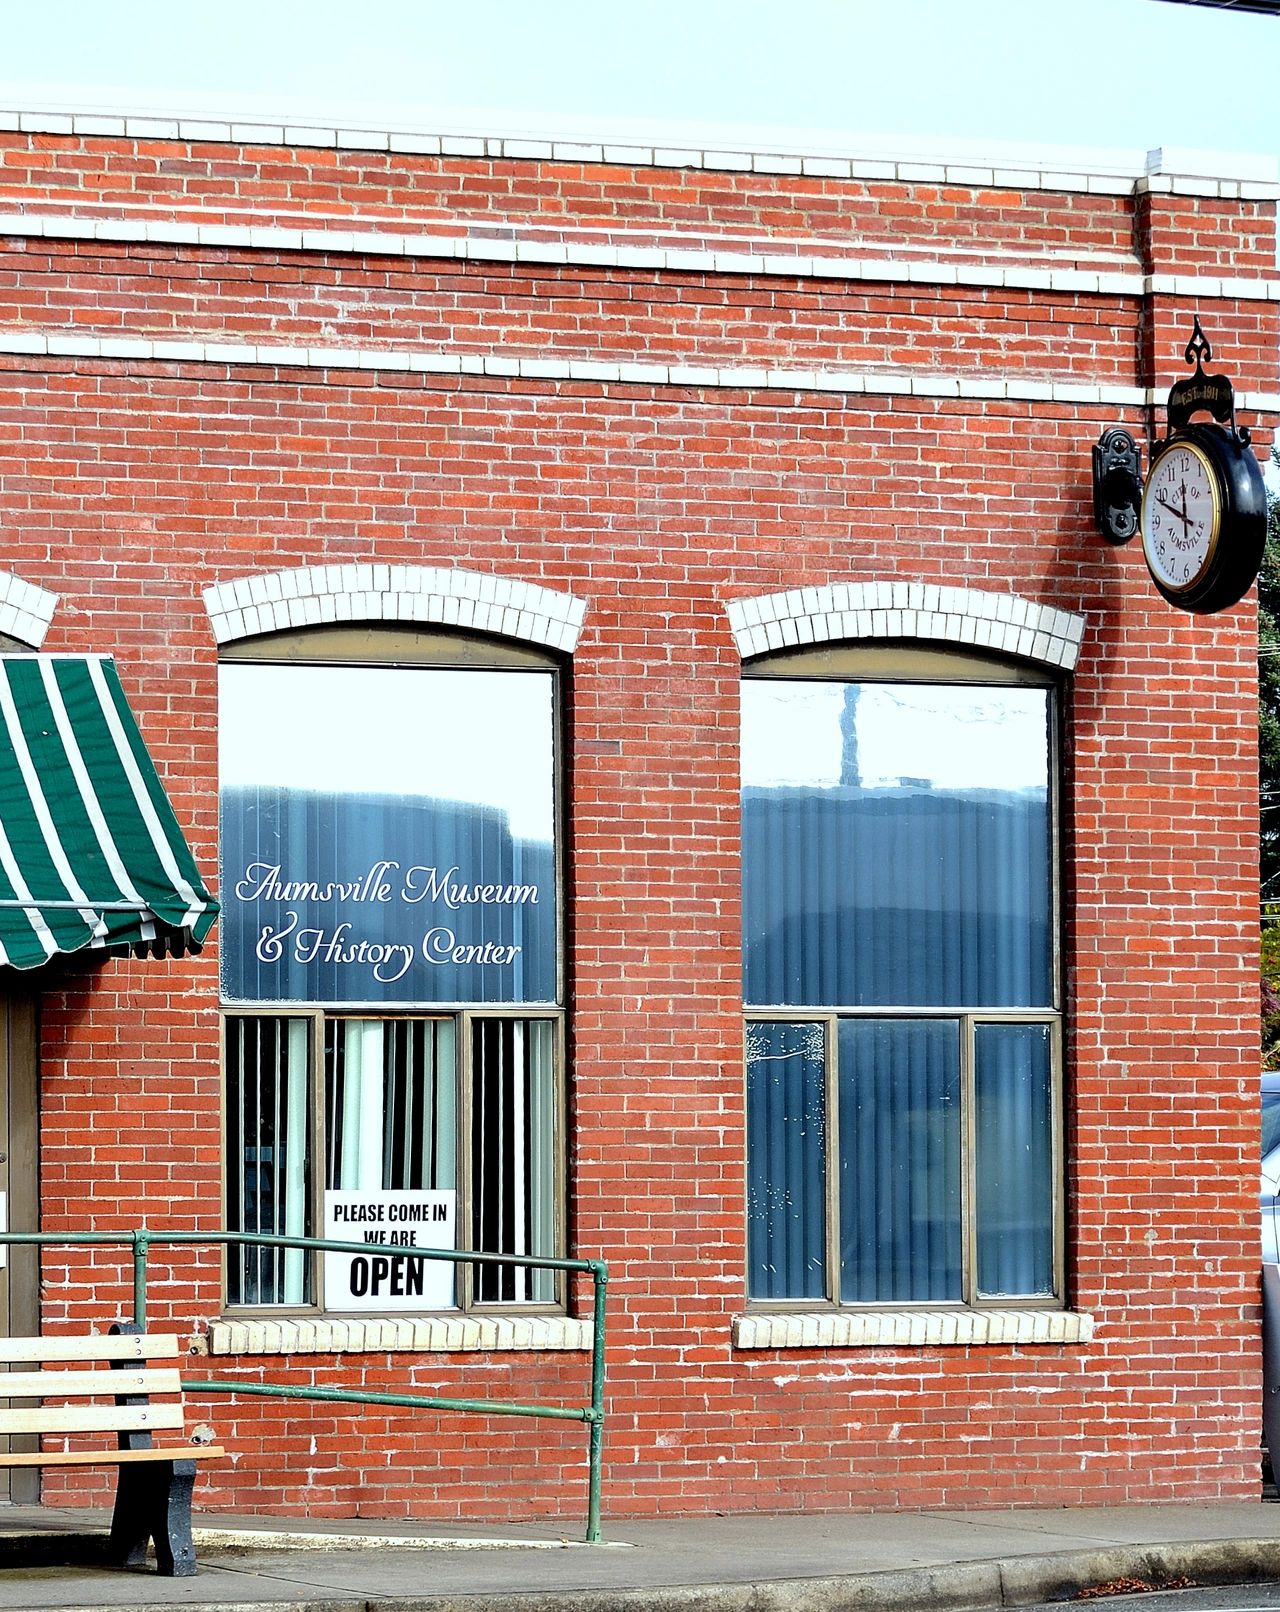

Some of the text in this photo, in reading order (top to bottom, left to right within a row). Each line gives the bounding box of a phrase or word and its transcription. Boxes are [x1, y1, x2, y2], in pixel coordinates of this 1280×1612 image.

[1203, 385, 1218, 401] 1911
[1181, 457, 1190, 472] 12
[1198, 463, 1202, 477] 1
[1168, 467, 1175, 482] 11
[1158, 487, 1168, 503] 10
[1171, 484, 1201, 504] CITY OF
[1154, 515, 1161, 530] 9
[1168, 521, 1205, 551] AUMSVILLE
[1159, 540, 1166, 555] 8
[1170, 557, 1176, 573] 7
[1183, 563, 1190, 578] 6
[235, 861, 539, 910] Aumsville Museum
[256, 911, 522, 983] & History Center
[334, 1204, 447, 1222] PLEASE COME IN
[364, 1230, 417, 1247] WE ARE
[349, 1256, 425, 1297] OPEN
